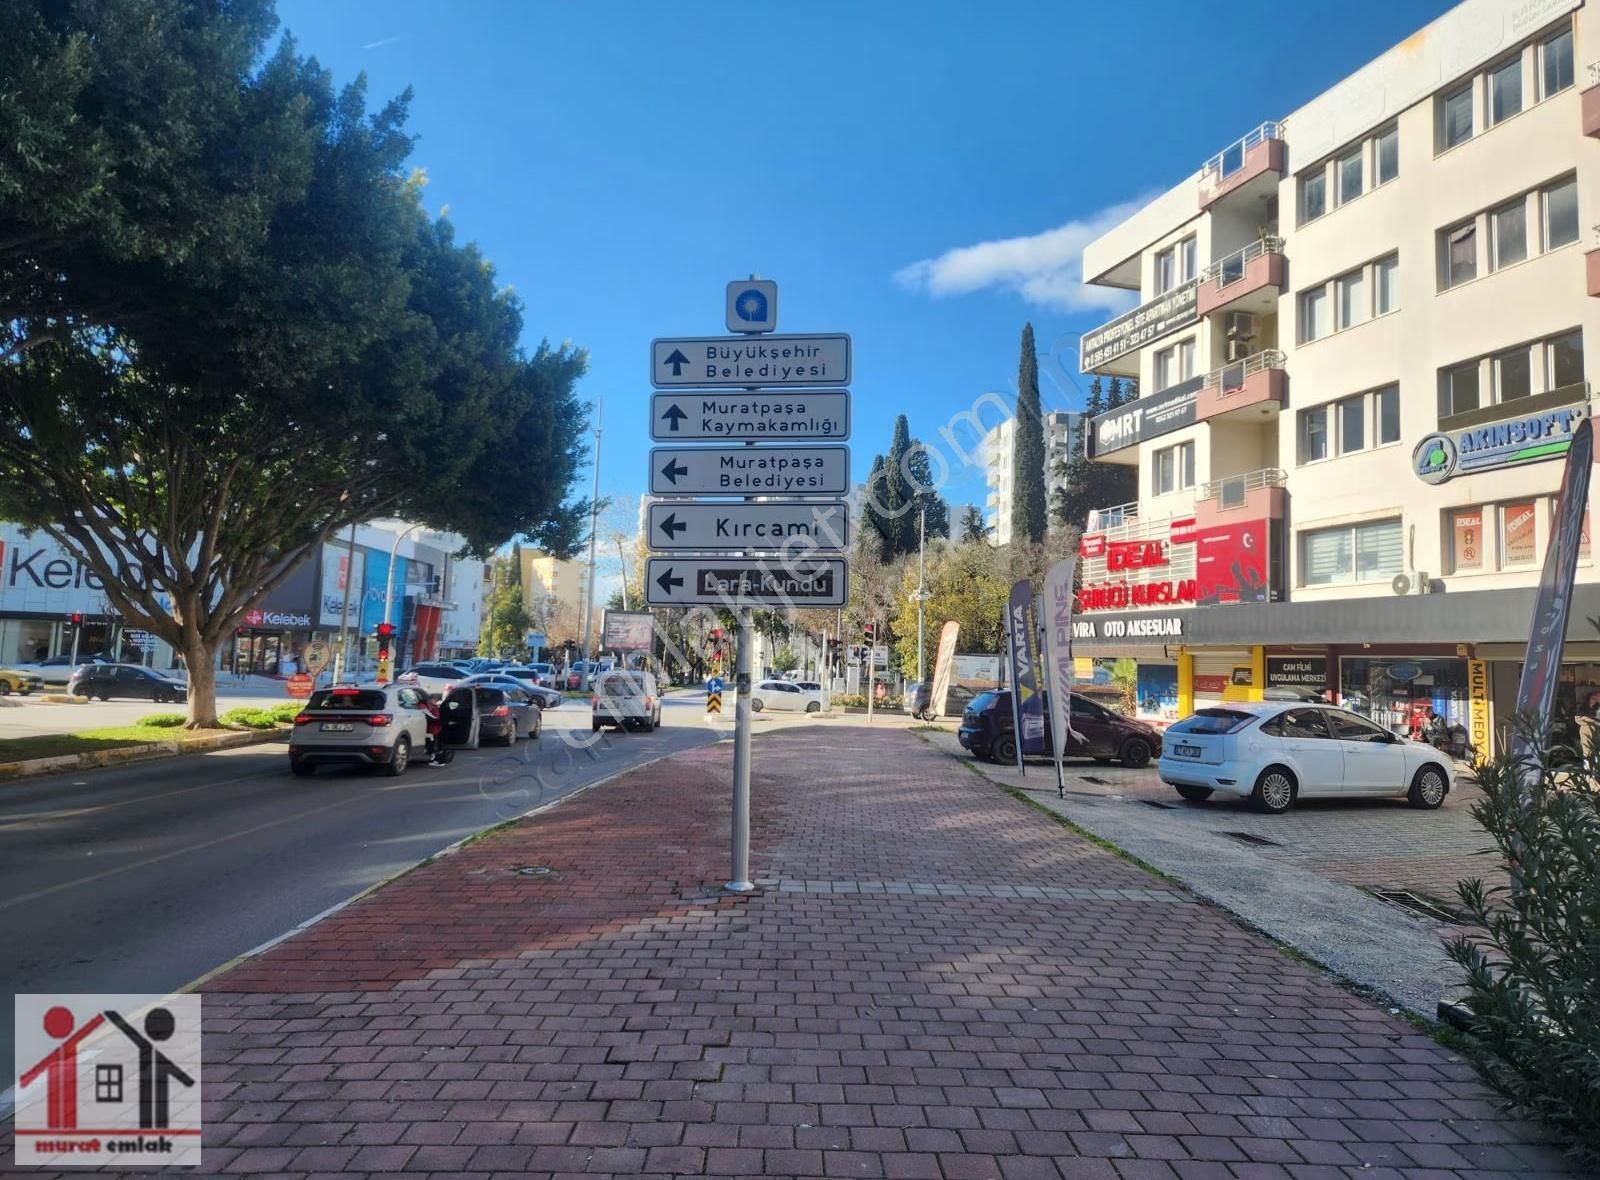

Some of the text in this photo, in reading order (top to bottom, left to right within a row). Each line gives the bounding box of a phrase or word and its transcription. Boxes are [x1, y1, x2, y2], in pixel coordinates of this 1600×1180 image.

[706, 345, 820, 362] Büyükşehir
[706, 363, 826, 379] Belediyesi
[702, 401, 806, 416] Muratpaşa
[702, 418, 838, 435] Kaymakamlığı
[1112, 408, 1144, 438] MRT
[1459, 409, 1574, 453] AKINSOFT
[720, 456, 824, 471] Muratpaşa
[720, 474, 824, 490] Belediyesi
[716, 517, 819, 538] Kırcami
[703, 571, 827, 593] Lara-Kundu
[263, 611, 311, 626] Kelebek
[1104, 620, 1126, 637] OTO
[1126, 618, 1183, 637] AKSESUAR
[1013, 604, 1030, 677] VARTA
[1283, 663, 1296, 671] CAM
[1270, 673, 1300, 682] UYGULAMA
